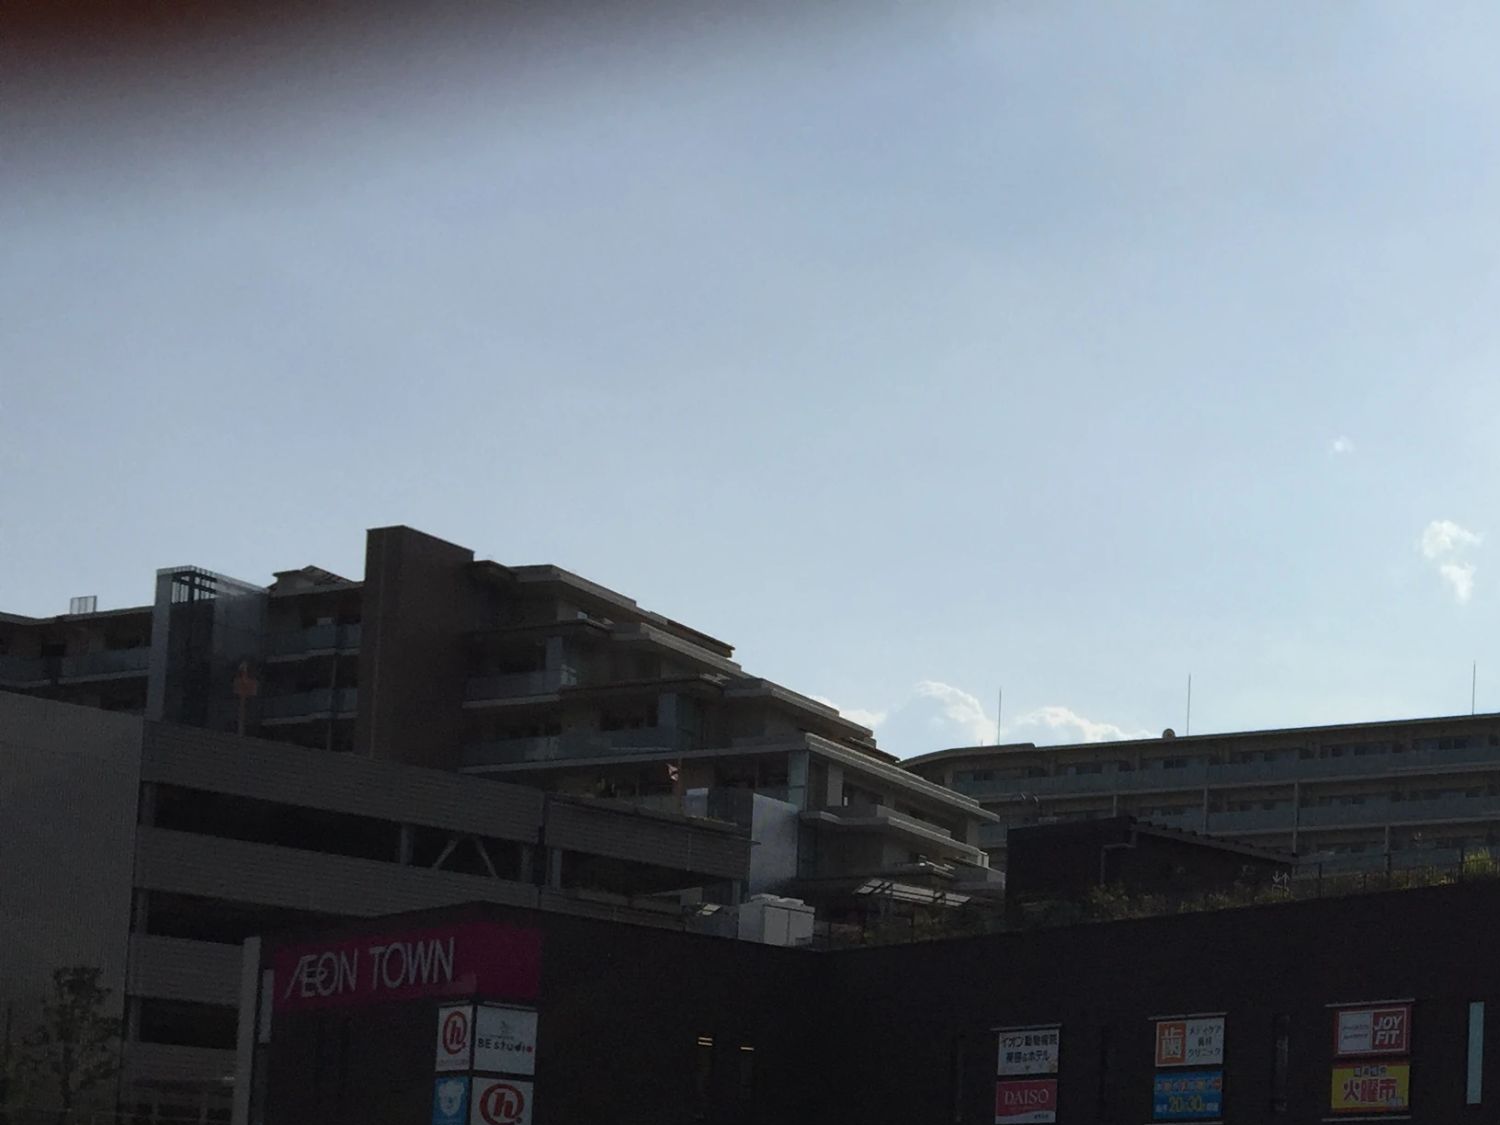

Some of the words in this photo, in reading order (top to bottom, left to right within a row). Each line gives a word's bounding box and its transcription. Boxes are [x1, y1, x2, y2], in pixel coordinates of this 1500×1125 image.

[368, 936, 455, 991] TOWN
[1374, 1016, 1403, 1030] JOY
[1004, 1088, 1049, 1105] DAISO
